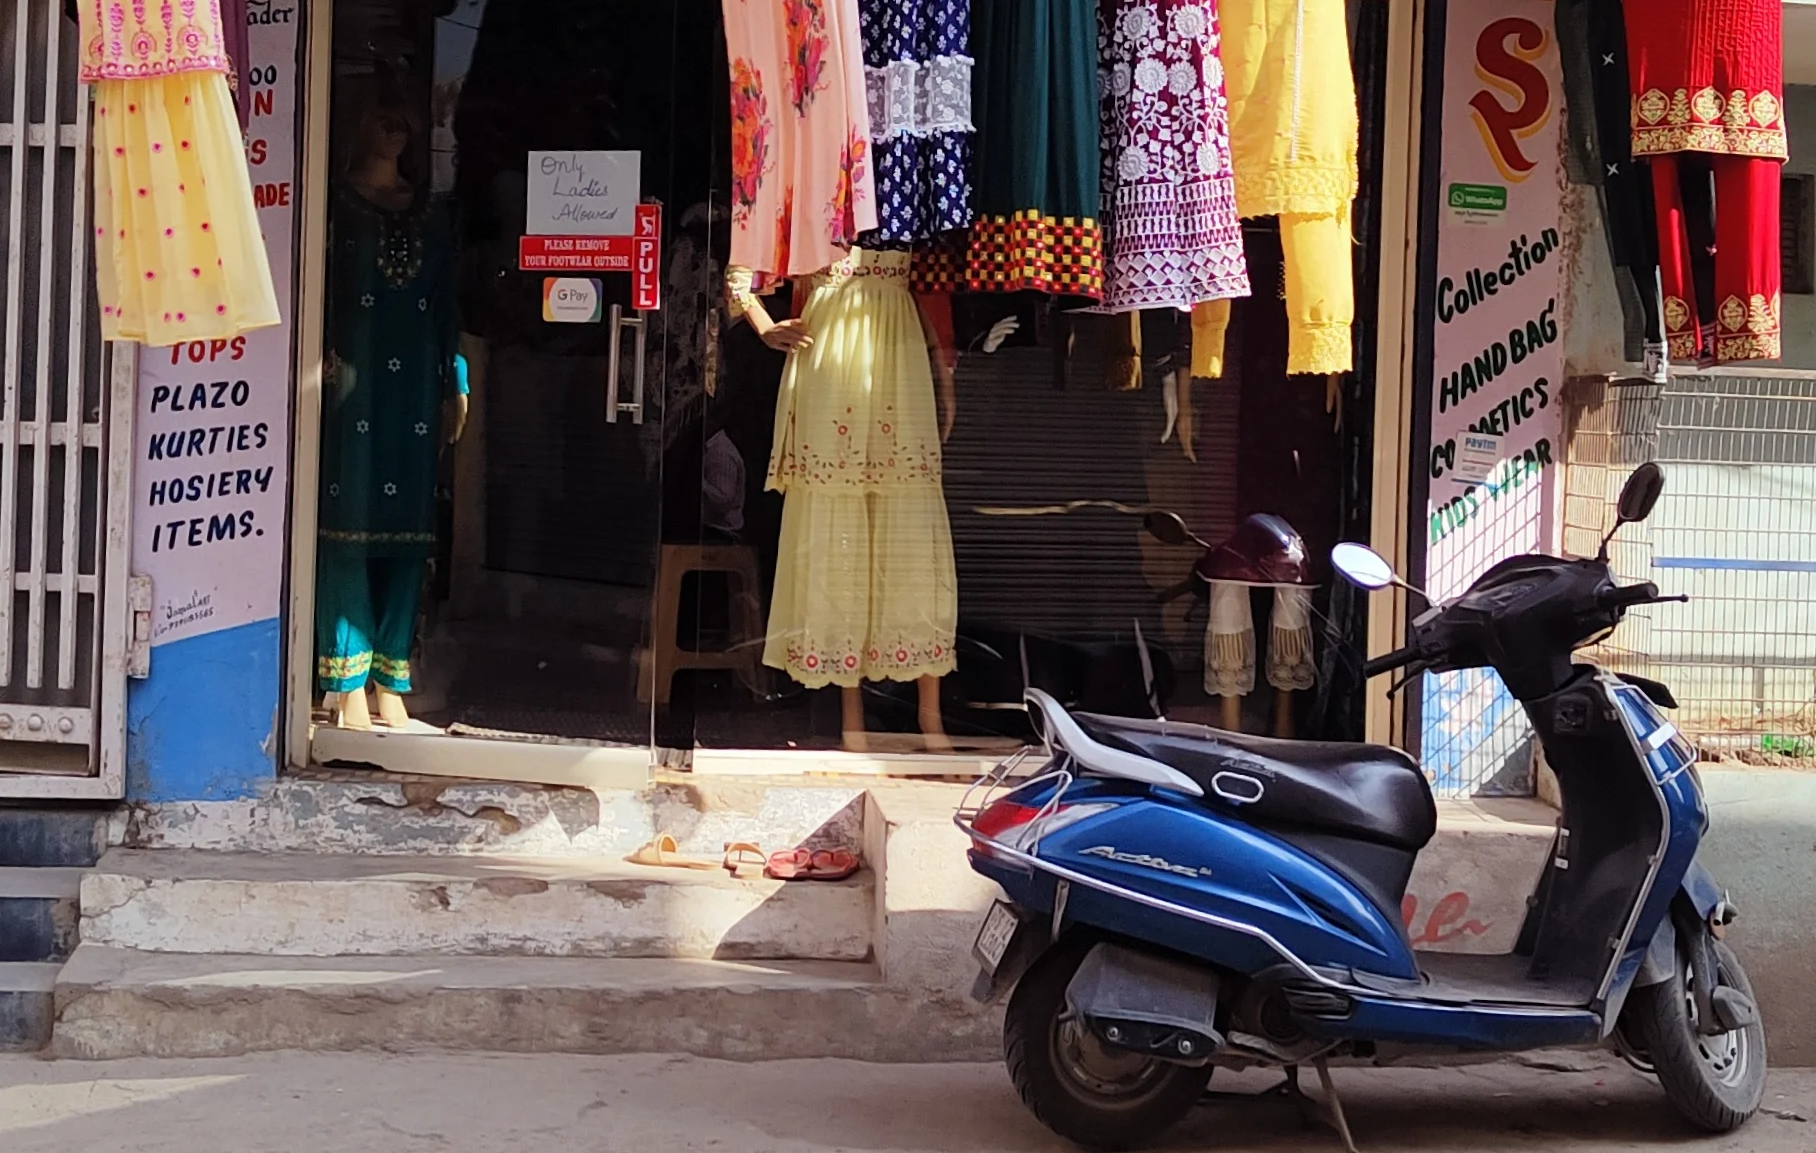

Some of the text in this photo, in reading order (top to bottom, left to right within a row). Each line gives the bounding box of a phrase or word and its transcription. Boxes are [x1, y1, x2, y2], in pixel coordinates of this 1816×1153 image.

[540, 154, 585, 182] Only
[254, 183, 290, 208] ADE
[553, 177, 609, 197] Ladies
[552, 203, 619, 223] Allowed
[544, 239, 610, 251] PLEASE REMOVE
[525, 255, 630, 267] YOUR FOOTWEAR OUTSIDE
[639, 241, 654, 306] PULL
[1437, 227, 1558, 324] Collection
[150, 380, 250, 414] PLAZO
[148, 422, 268, 461] KURTIES
[149, 466, 274, 507] HOSIERY
[151, 510, 264, 552] ITEMS.
